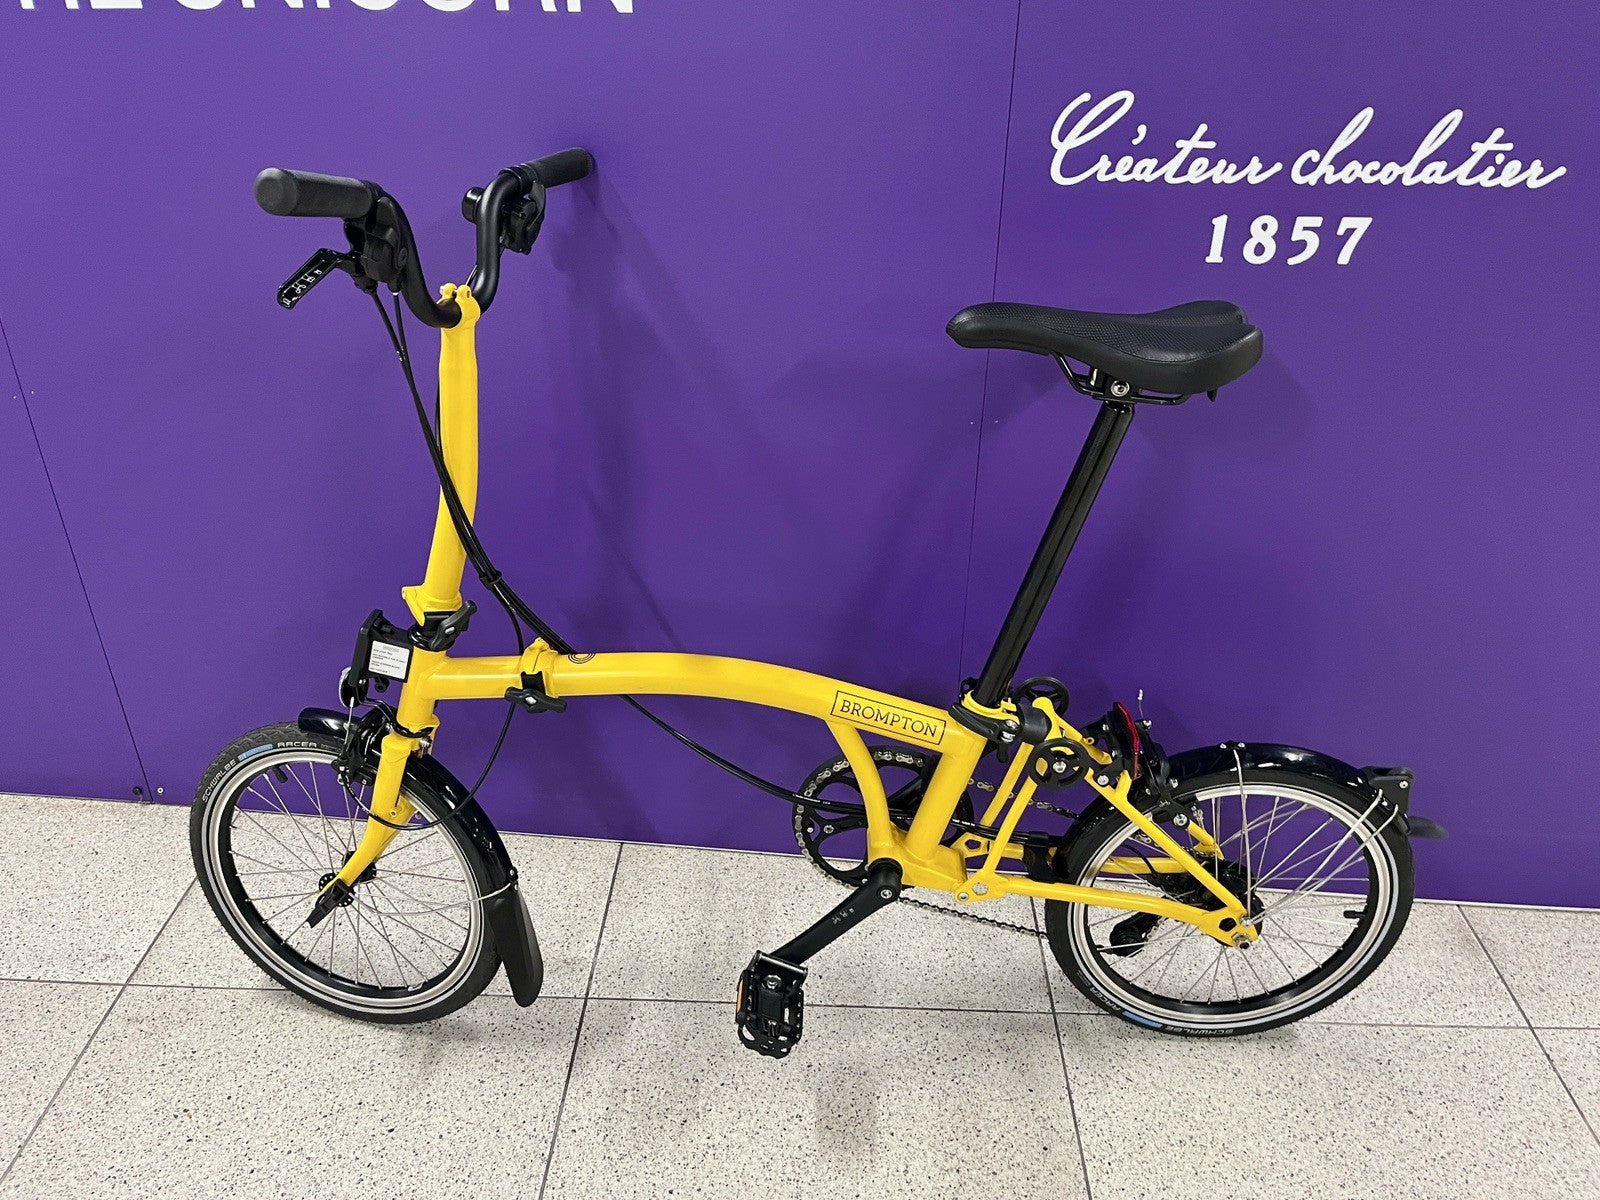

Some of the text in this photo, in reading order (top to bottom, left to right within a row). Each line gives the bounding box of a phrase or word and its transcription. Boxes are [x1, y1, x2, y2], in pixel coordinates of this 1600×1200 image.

[1050, 89, 1567, 189] Créateur chocolatier
[1204, 213, 1373, 266] 1857
[840, 699, 938, 737] BROMPTON
[202, 759, 237, 803] SCHWALBE
